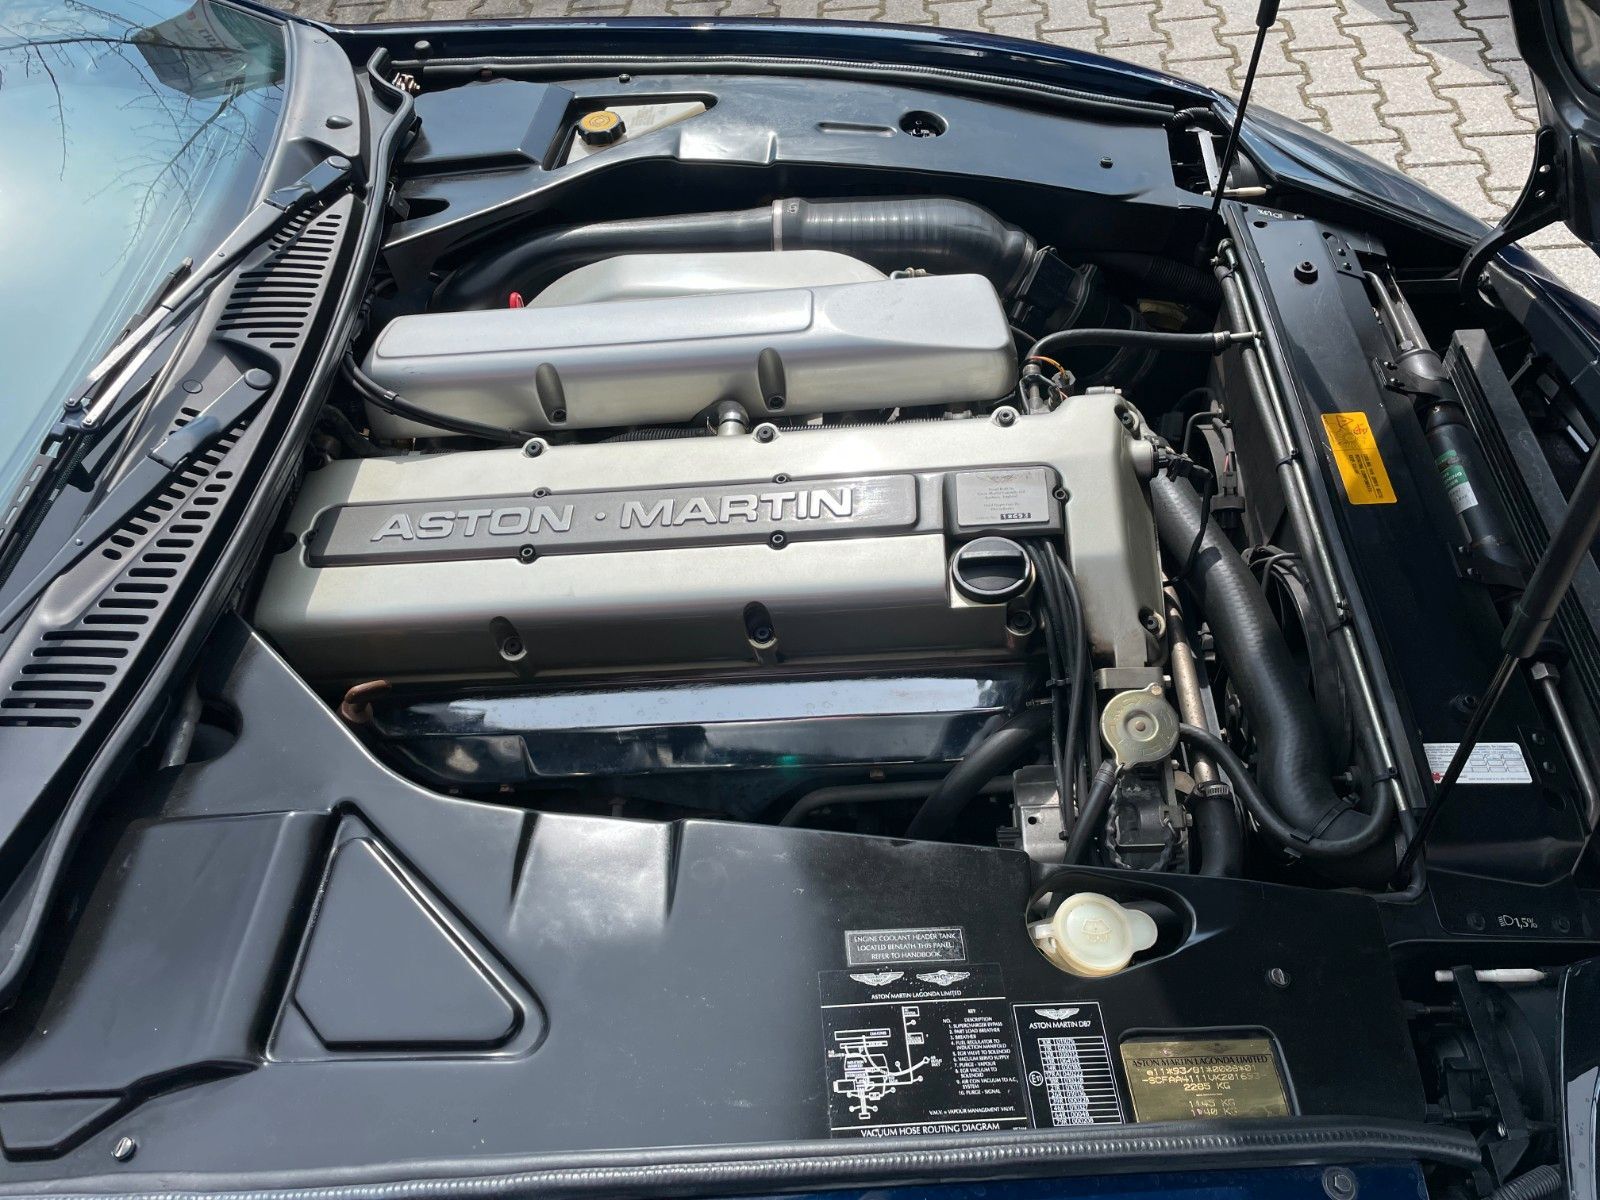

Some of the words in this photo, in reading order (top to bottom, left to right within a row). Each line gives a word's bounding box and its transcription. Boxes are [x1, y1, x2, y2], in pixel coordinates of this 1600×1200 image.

[371, 504, 574, 543] ASTON
[618, 488, 857, 529] MARTIN
[878, 934, 910, 942] COOLANT
[888, 942, 916, 950] BENEATH
[1029, 1022, 1052, 1030] ASTON
[1078, 1020, 1091, 1028] DB7
[1133, 1059, 1160, 1067] ASTON
[1161, 1058, 1194, 1066] MARTIN
[1194, 1056, 1235, 1065] LAGONDA
[1236, 1055, 1268, 1064] LIMITED
[1216, 1082, 1231, 1090] KG
[1221, 1098, 1236, 1107] KG
[860, 1128, 898, 1138] VACUUM
[900, 1126, 921, 1135] HOSE
[922, 1124, 960, 1134] ROUTING
[962, 1122, 1000, 1132] DIAGRAM
